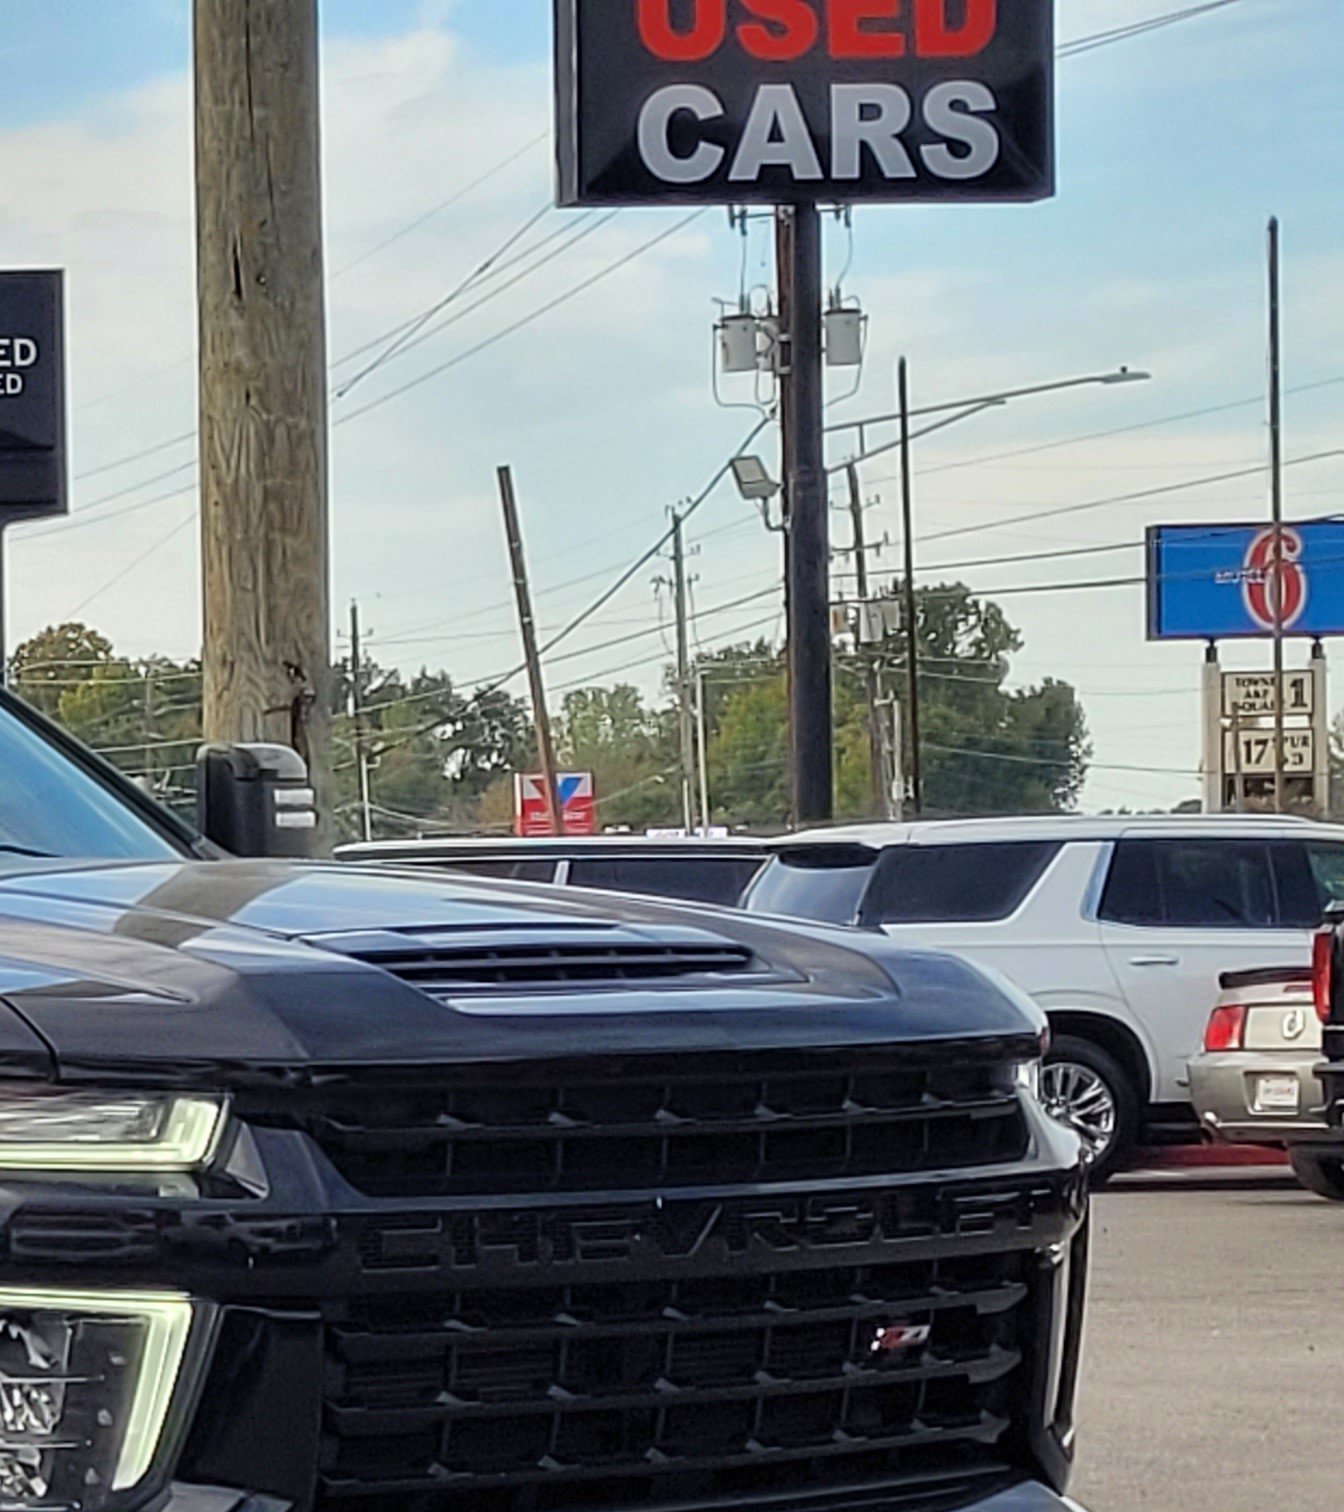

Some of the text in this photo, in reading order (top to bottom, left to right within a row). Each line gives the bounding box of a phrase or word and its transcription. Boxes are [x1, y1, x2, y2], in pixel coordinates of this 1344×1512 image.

[637, 0, 996, 60] USED
[637, 81, 1000, 184] CARS
[359, 1188, 1053, 1273] CHEVROLET
